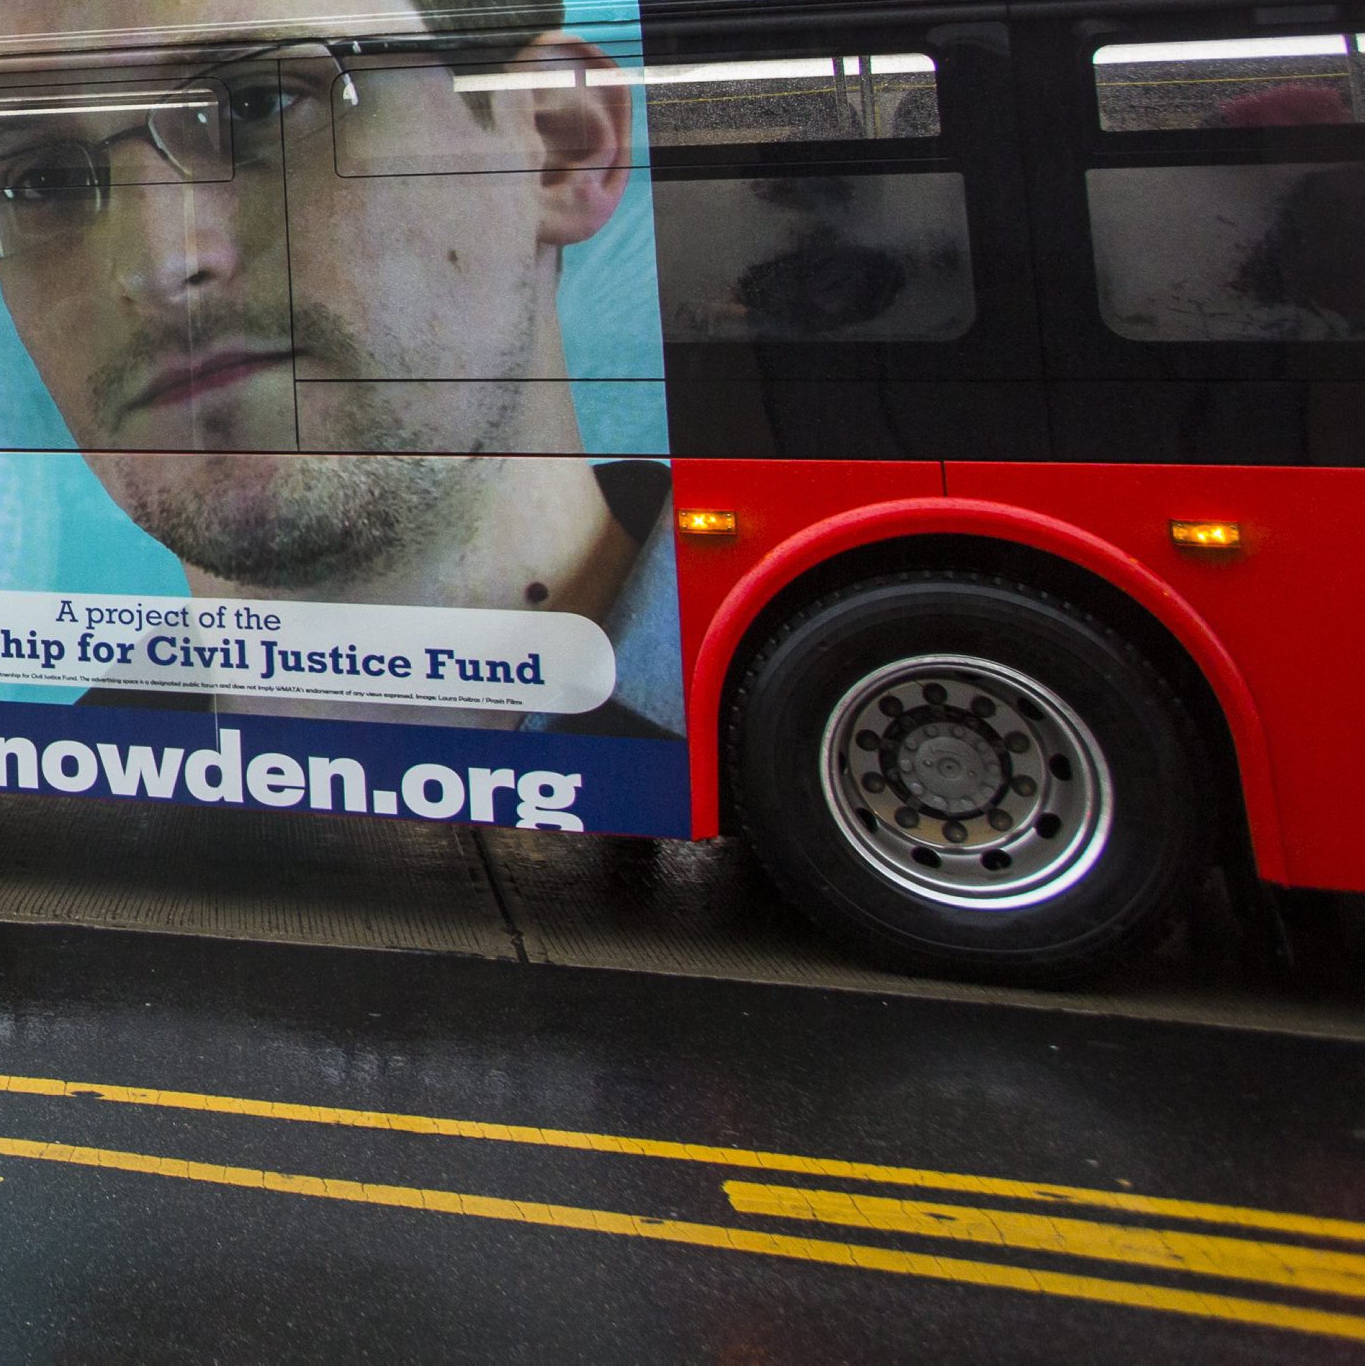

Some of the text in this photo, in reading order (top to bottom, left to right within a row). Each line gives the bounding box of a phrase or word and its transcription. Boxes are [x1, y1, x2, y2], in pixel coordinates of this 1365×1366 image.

[56, 600, 281, 631] A project of the
[78, 632, 135, 664] for
[146, 635, 250, 670] Civil
[260, 640, 412, 679] Justice
[424, 648, 545, 686] Fund
[91, 677, 122, 685] advertising
